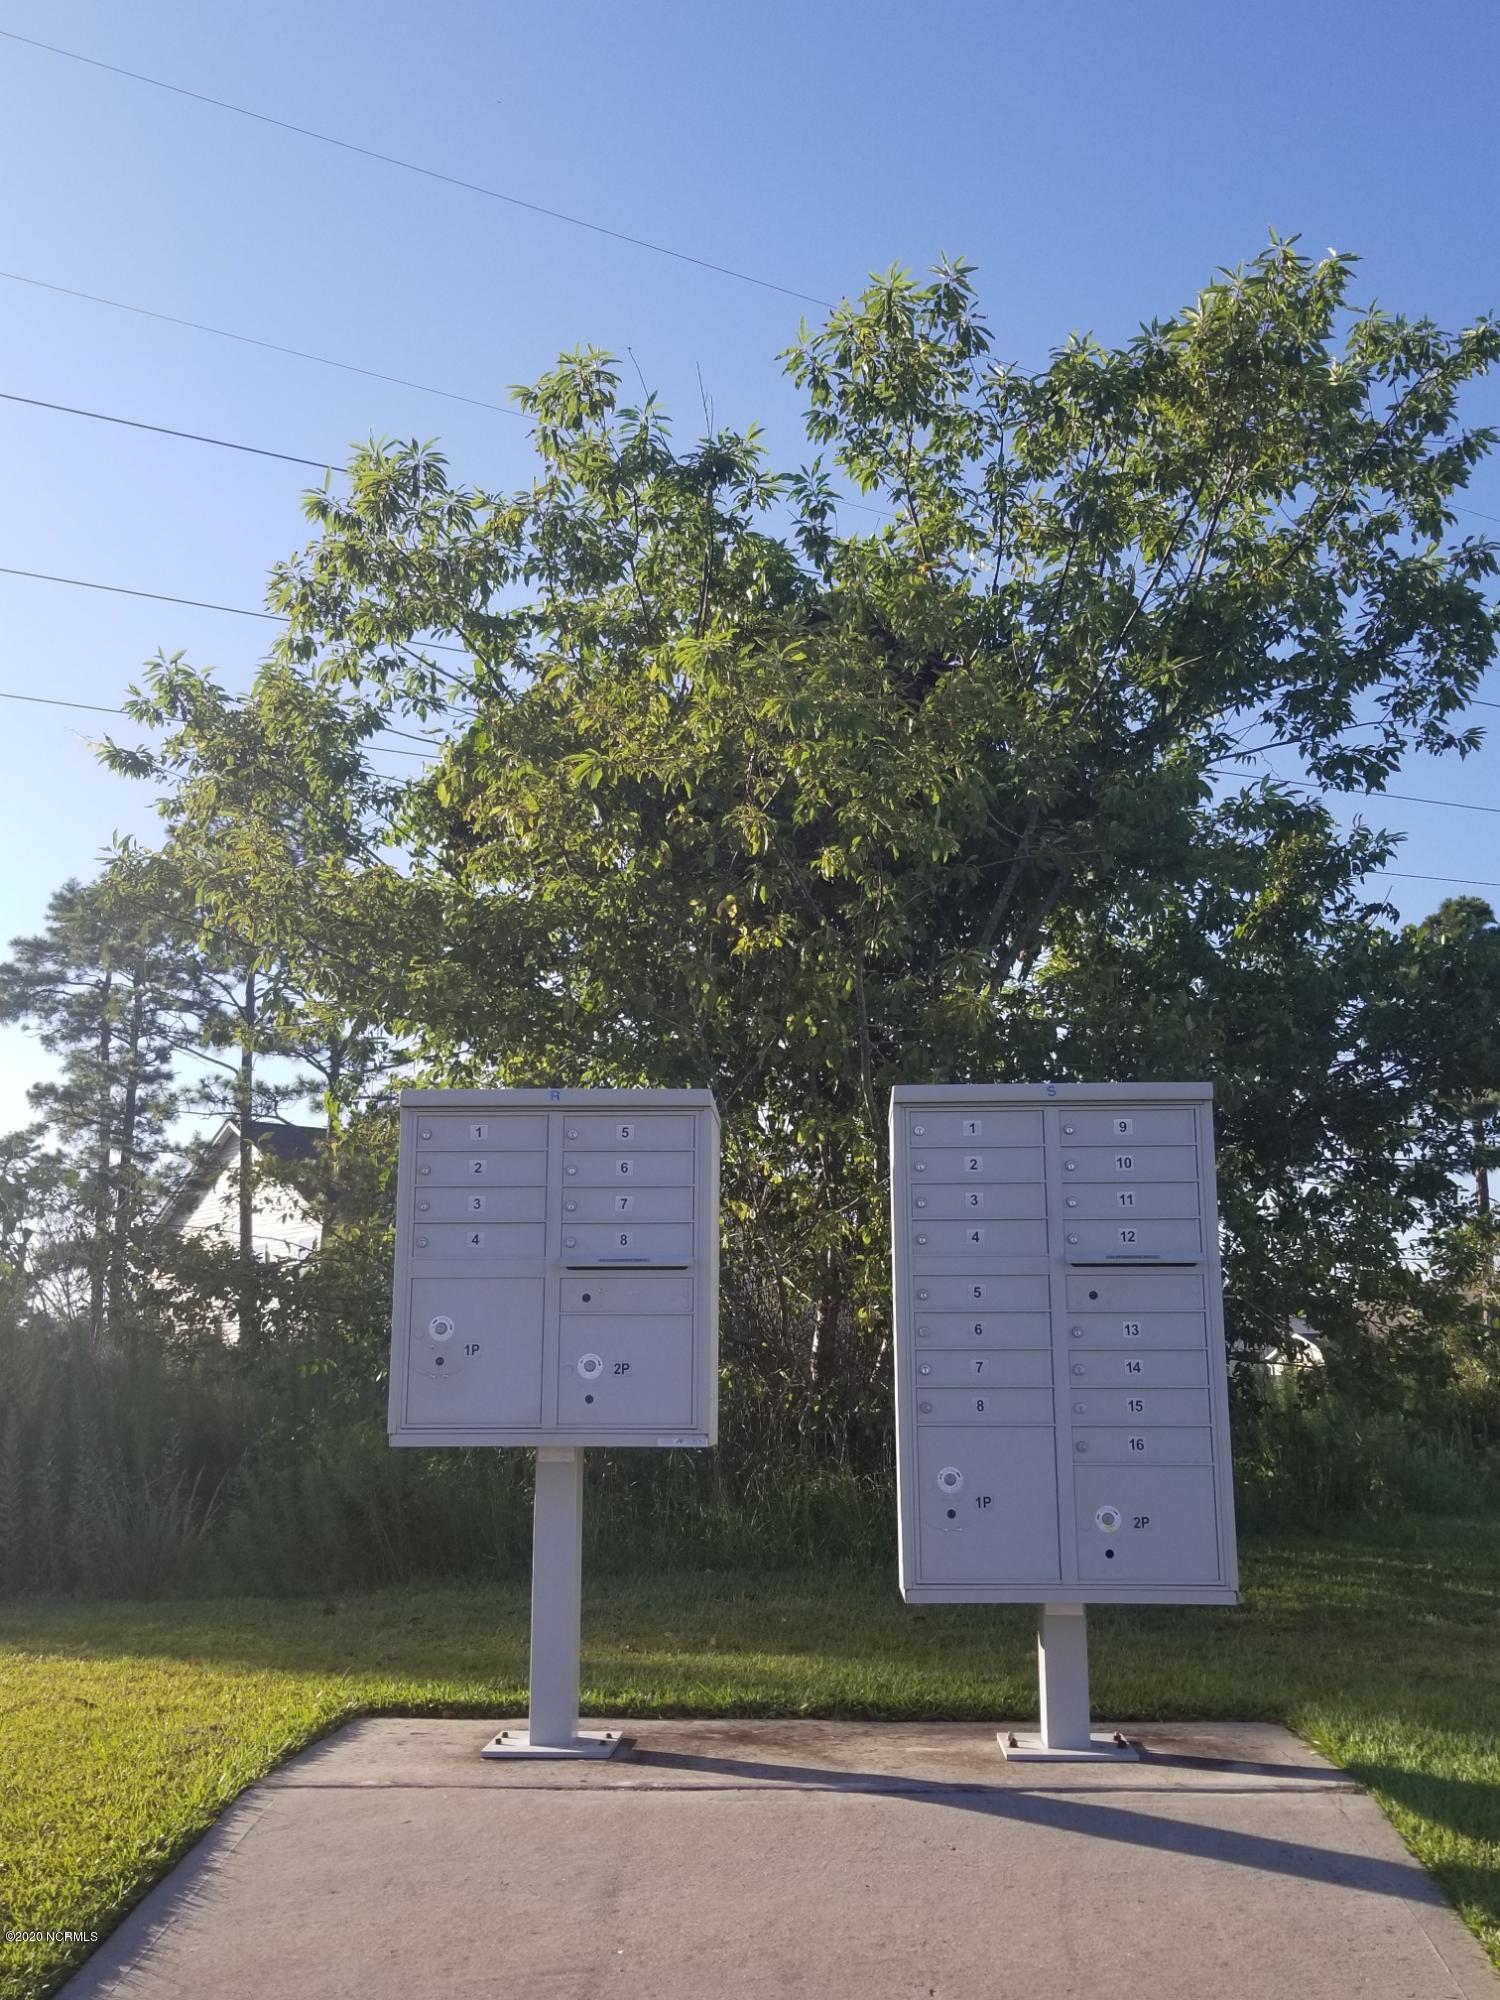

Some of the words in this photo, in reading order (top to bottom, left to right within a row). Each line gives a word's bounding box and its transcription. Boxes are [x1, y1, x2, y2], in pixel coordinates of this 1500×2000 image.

[550, 1090, 561, 1101] R
[1046, 1086, 1057, 1097] S
[475, 1126, 482, 1138] 1
[621, 1126, 630, 1138] 5
[969, 1122, 975, 1134] 1
[1118, 1121, 1127, 1133] 9
[474, 1162, 482, 1174] 2
[620, 1162, 629, 1174] 6
[969, 1158, 978, 1171] 2
[1116, 1157, 1132, 1169] 10
[473, 1198, 481, 1210] 3
[620, 1198, 628, 1210] 7
[970, 1194, 979, 1206] 3
[1119, 1193, 1133, 1206] 11
[471, 1234, 480, 1246] 4
[619, 1234, 628, 1246] 8
[971, 1231, 980, 1243] 4
[1120, 1230, 1136, 1243] 12
[973, 1286, 982, 1299] 5
[974, 1323, 983, 1336] 6
[1124, 1323, 1140, 1336] 13
[464, 1343, 480, 1356] 1P
[613, 1362, 630, 1375] 2P
[975, 1361, 984, 1374] 7
[1126, 1361, 1142, 1374] 14
[976, 1399, 985, 1412] 8
[1127, 1399, 1143, 1413] 15
[1129, 1438, 1145, 1451] 16
[975, 1496, 992, 1509] 1P
[1133, 1516, 1150, 1529] 2P
